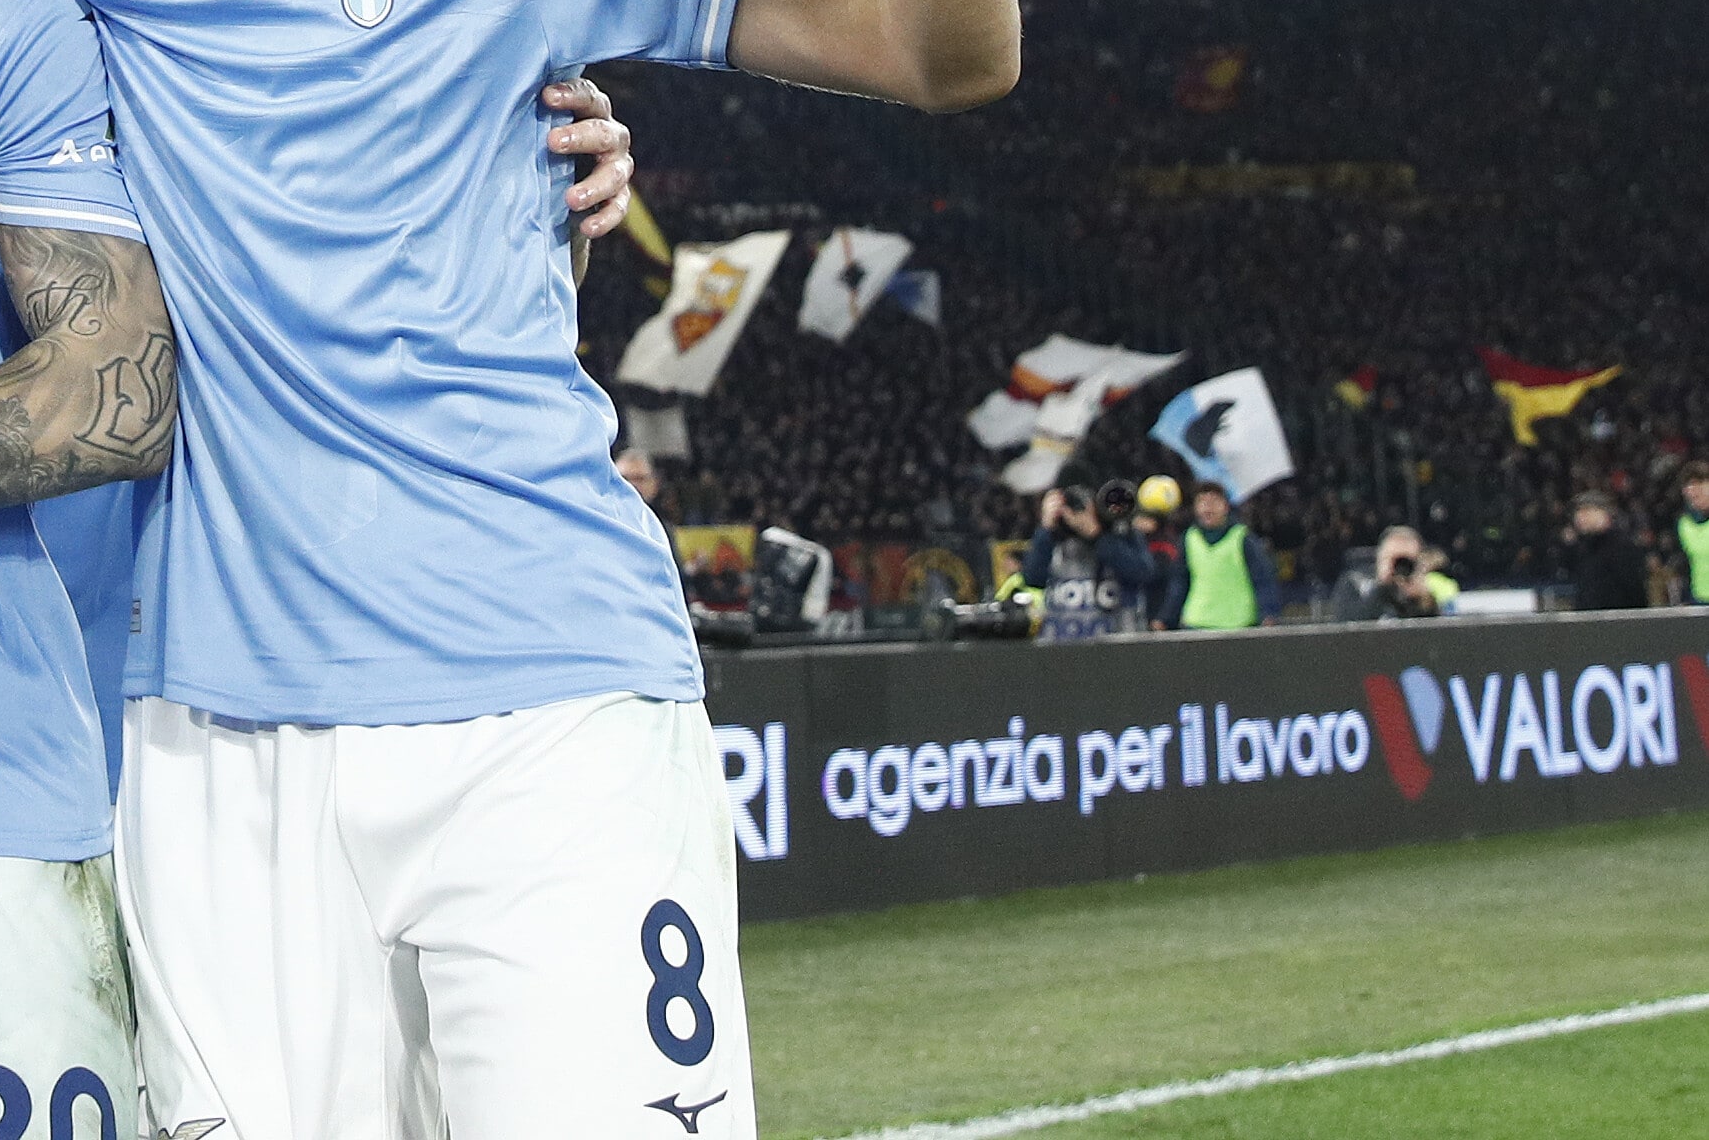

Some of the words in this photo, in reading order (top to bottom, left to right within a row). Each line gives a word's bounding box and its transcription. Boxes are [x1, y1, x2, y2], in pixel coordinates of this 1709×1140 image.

[823, 715, 1066, 837] agenzia
[1077, 723, 1174, 817] per
[1179, 702, 1207, 788] il
[1214, 701, 1369, 784] lavoro
[1449, 662, 1679, 784] VALORI
[640, 899, 715, 1066] 8
